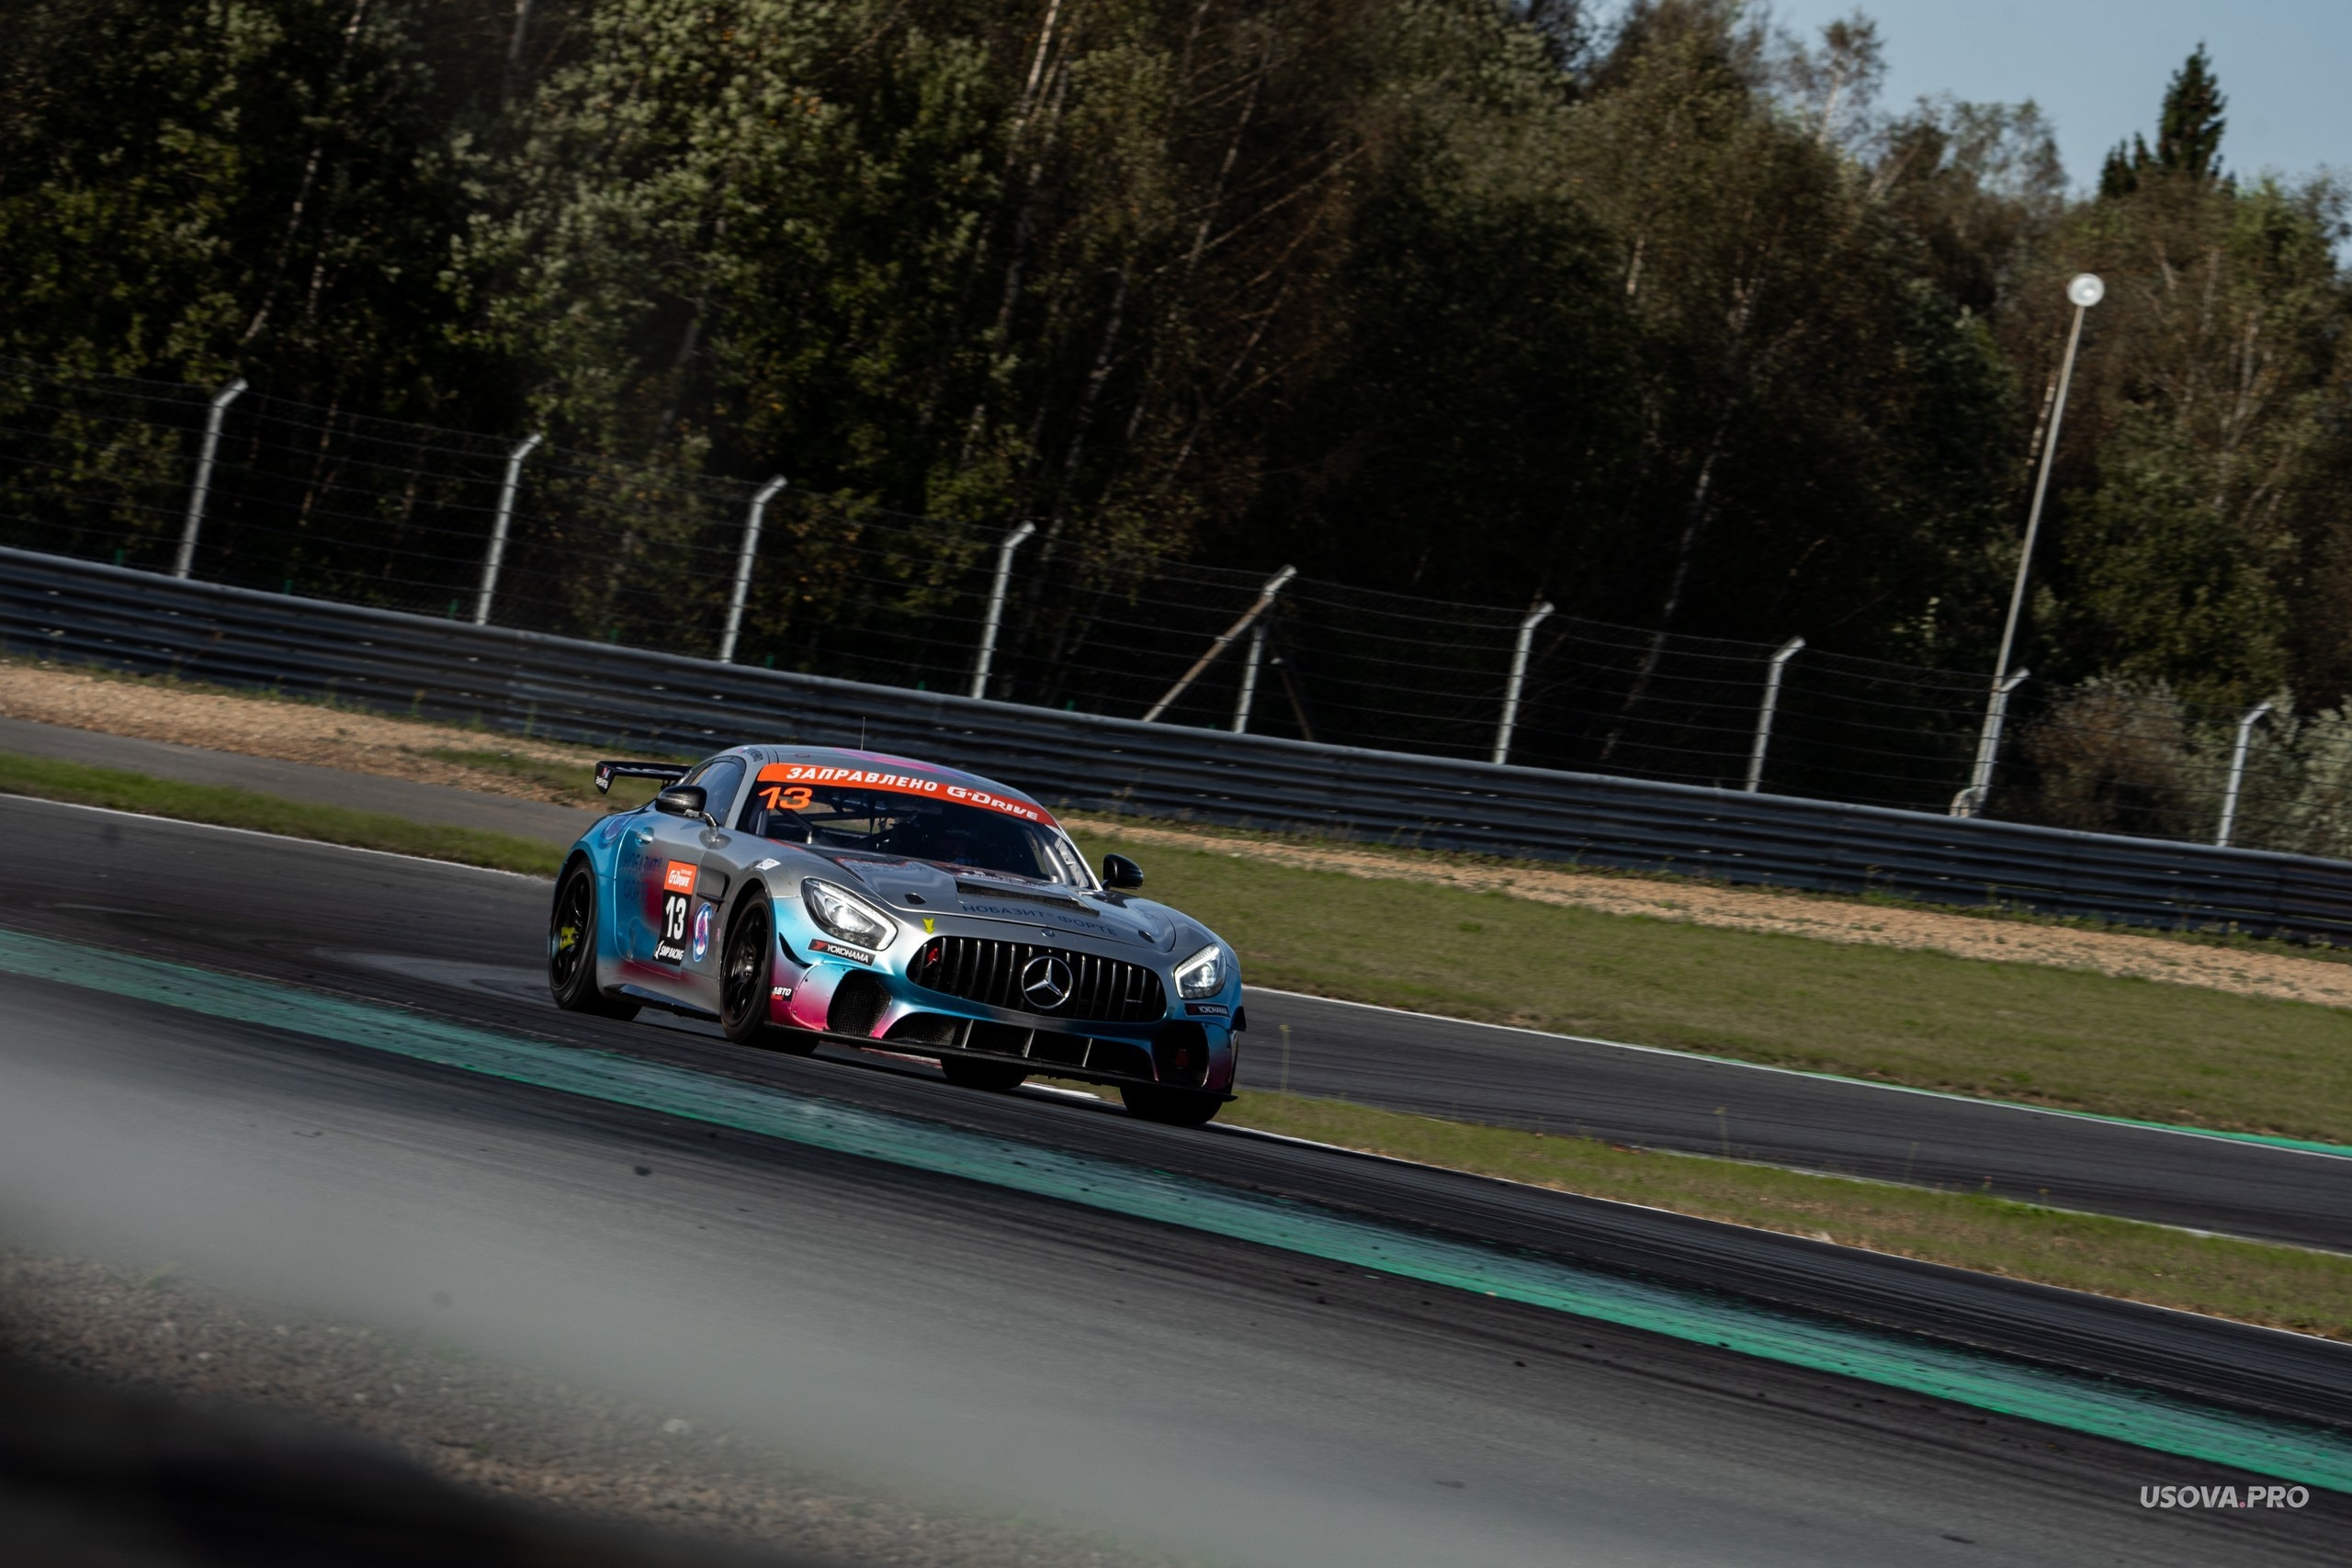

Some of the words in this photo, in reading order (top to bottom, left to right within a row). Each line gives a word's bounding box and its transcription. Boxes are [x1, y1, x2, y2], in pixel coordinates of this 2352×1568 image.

[786, 767, 937, 792] ЗАПРАВЛЕНО
[758, 786, 813, 809] 13
[665, 896, 687, 940] 13
[1057, 914, 1118, 937] ФОРТЕ
[667, 947, 684, 961] RACING
[827, 944, 869, 964] YOKOHAMA
[1198, 1006, 1228, 1016] YOKOHAMA
